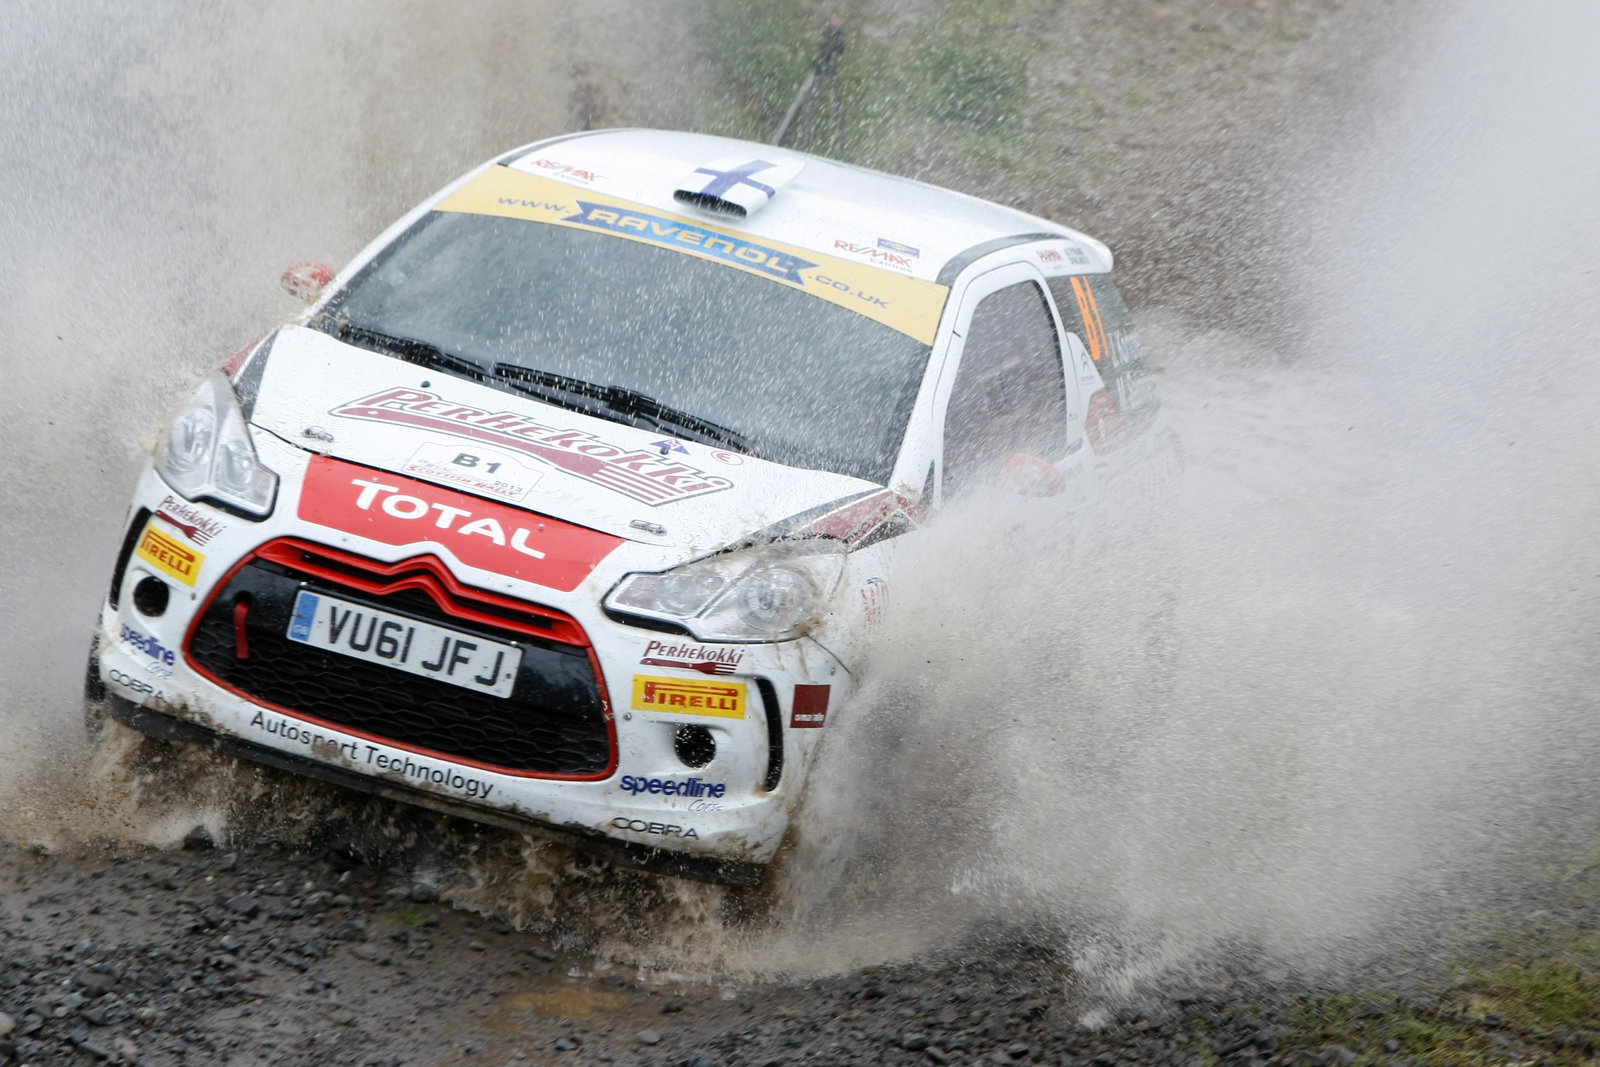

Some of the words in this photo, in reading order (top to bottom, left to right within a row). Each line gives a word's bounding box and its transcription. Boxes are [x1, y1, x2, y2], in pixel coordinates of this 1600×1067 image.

[834, 239, 913, 268] RE/MAX
[451, 452, 502, 474] B1
[351, 479, 545, 559] TOTAL
[141, 529, 196, 576] PIRELLI
[329, 606, 414, 663] VU61
[643, 681, 738, 711] PIRELLI
[366, 745, 494, 799] Technology
[620, 775, 726, 798] speedline
[612, 817, 699, 840] COBRA
